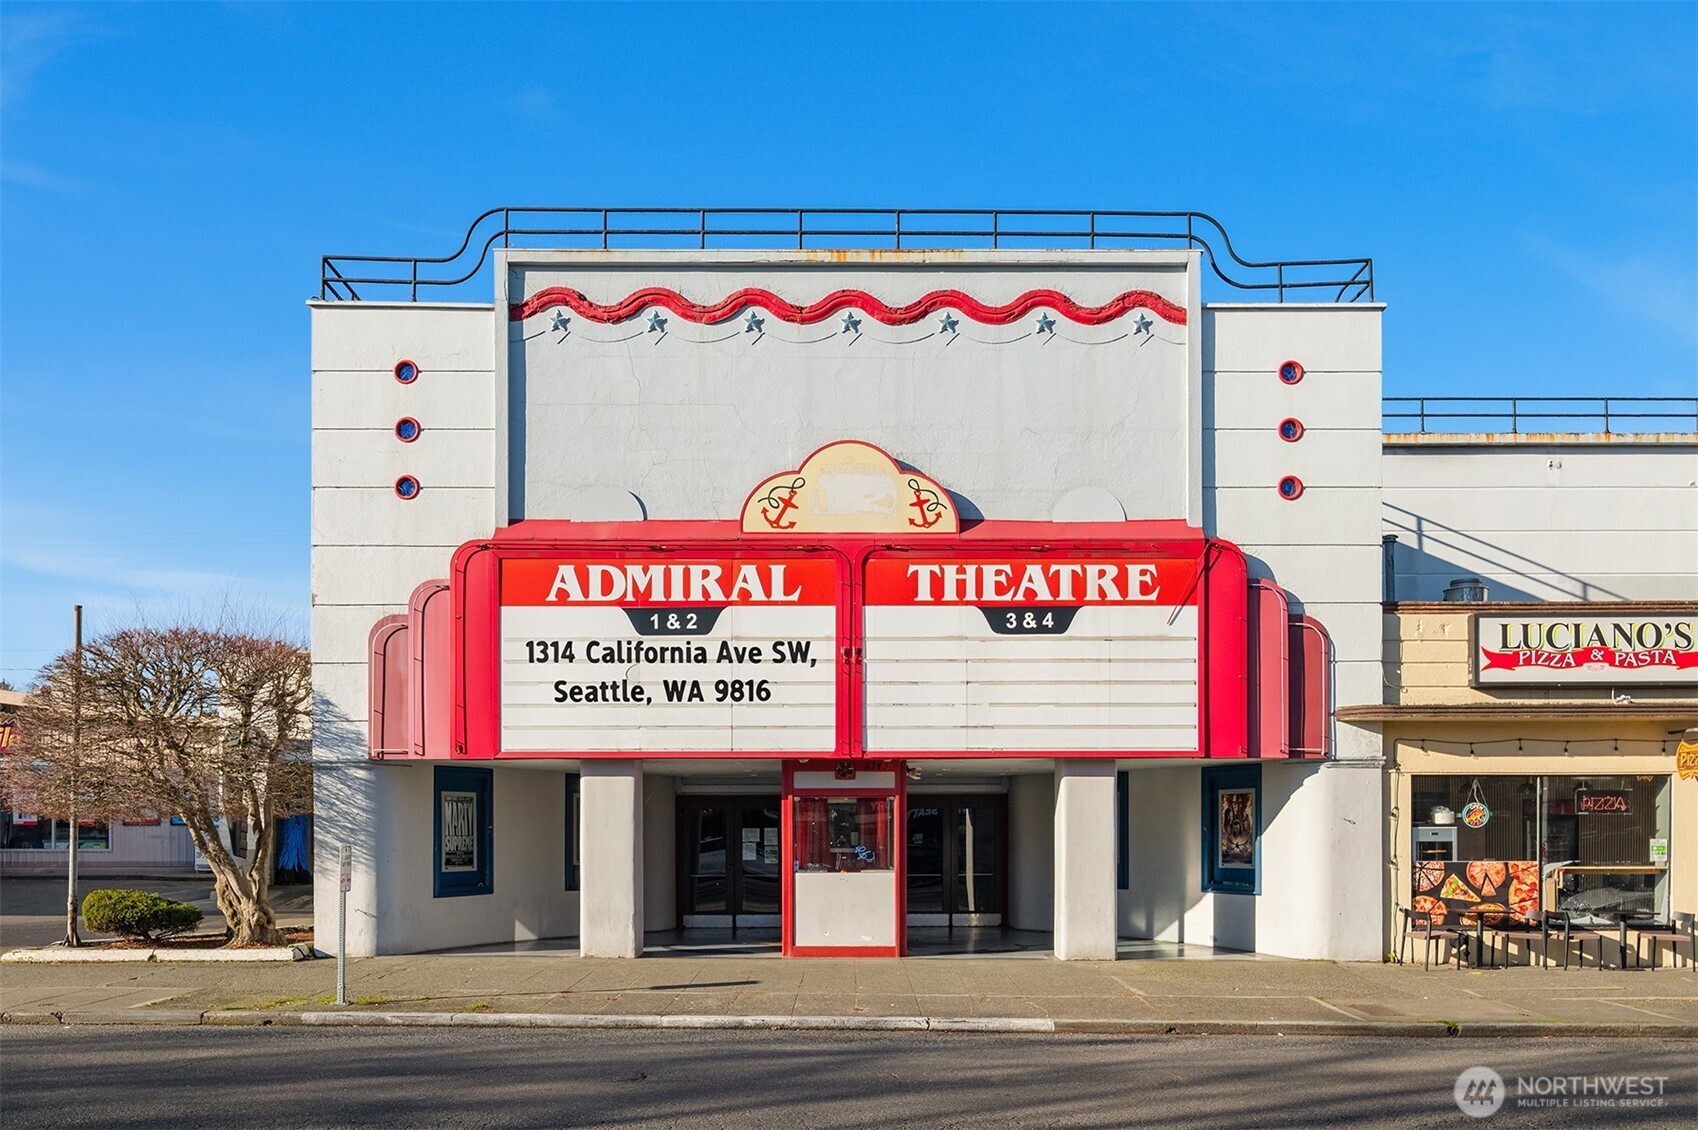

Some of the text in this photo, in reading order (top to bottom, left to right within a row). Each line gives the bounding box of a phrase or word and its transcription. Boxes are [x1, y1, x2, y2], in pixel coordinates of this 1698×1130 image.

[545, 564, 802, 602] ADMIRAL
[906, 564, 1161, 601] THEATRE
[650, 614, 697, 630] 1 & 2
[1006, 613, 1054, 629] 3 & 4
[525, 640, 817, 668] 1314 California Ave SW,
[1518, 650, 1575, 668] PIZZA
[1590, 648, 1604, 661] &
[1614, 649, 1677, 667] PASTA
[554, 680, 772, 705] Seattle, WA 9816
[1580, 796, 1627, 811] PIZZA
[445, 802, 473, 836] MARTY
[445, 836, 473, 851] SUPREME
